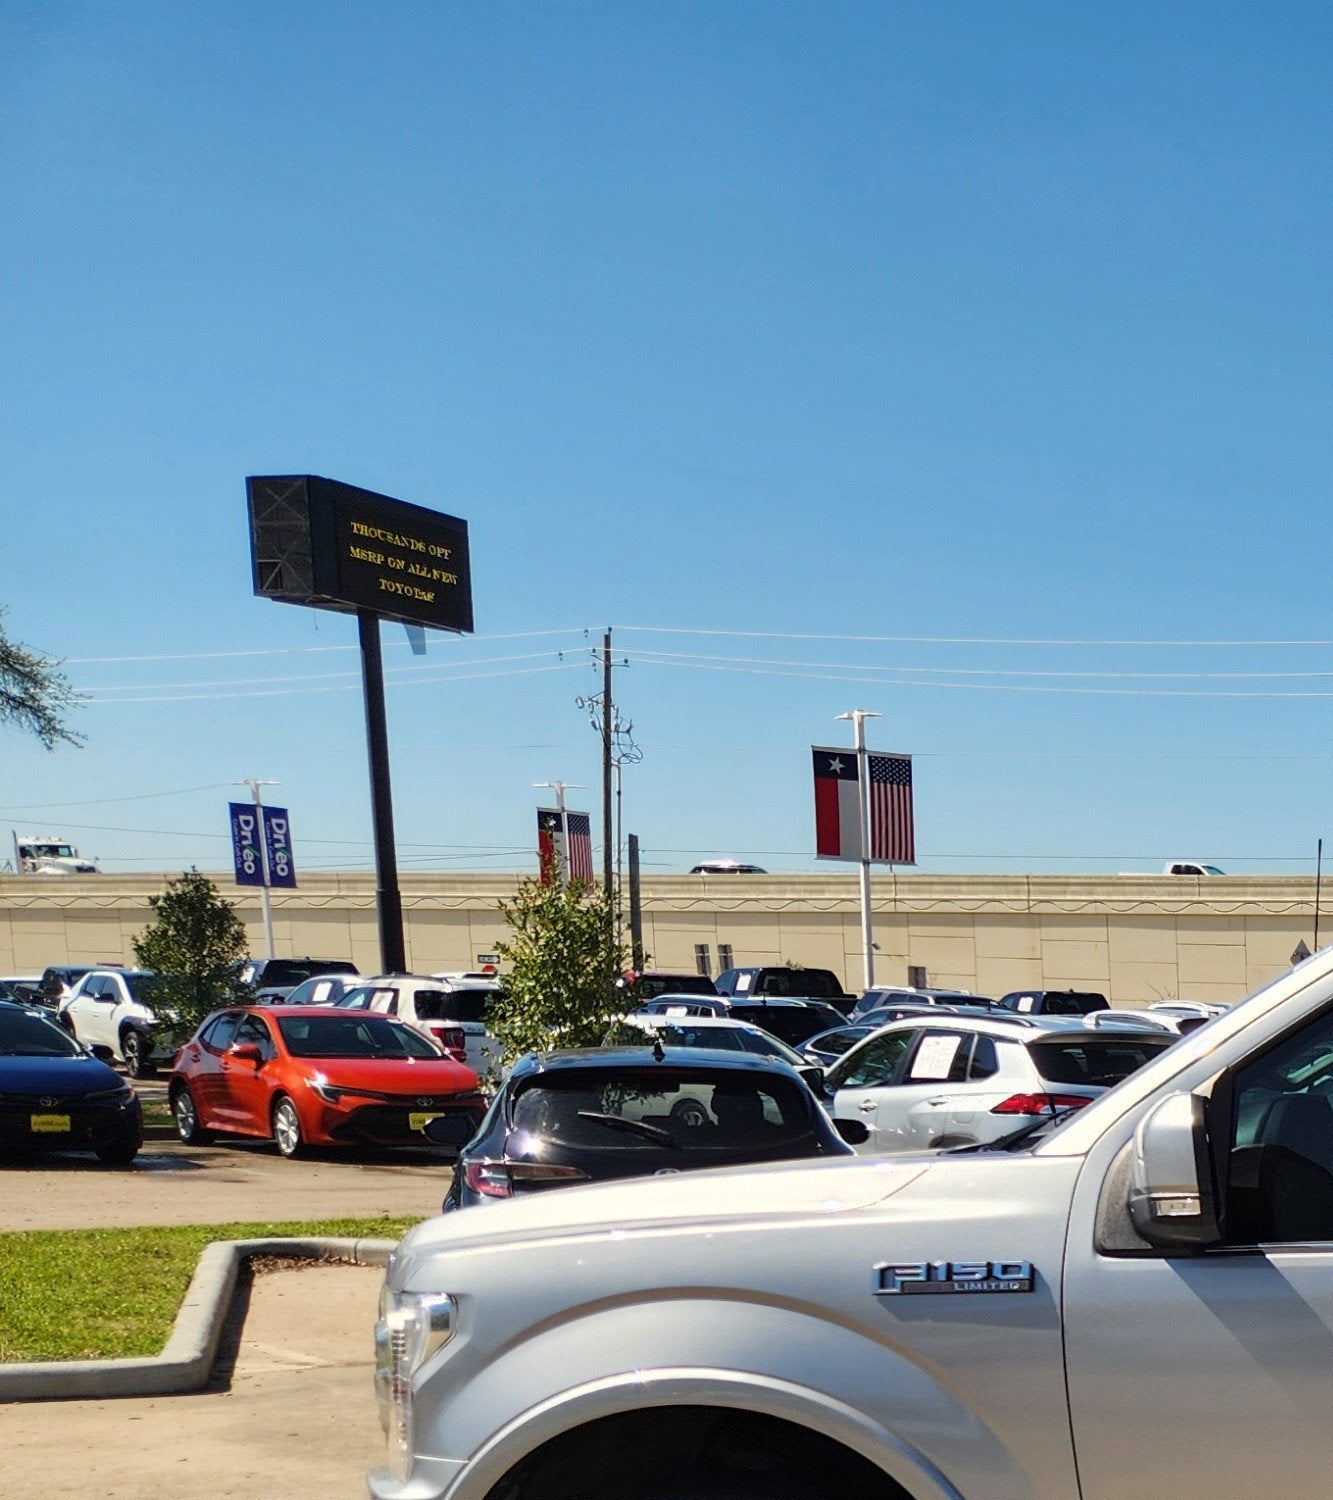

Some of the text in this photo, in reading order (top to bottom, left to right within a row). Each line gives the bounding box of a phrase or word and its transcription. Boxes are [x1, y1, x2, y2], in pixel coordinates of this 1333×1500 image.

[350, 521, 426, 551] THOUSANDS
[349, 545, 385, 566] MSRP
[407, 563, 432, 579] ALL
[953, 1281, 1021, 1292] LIMITED
